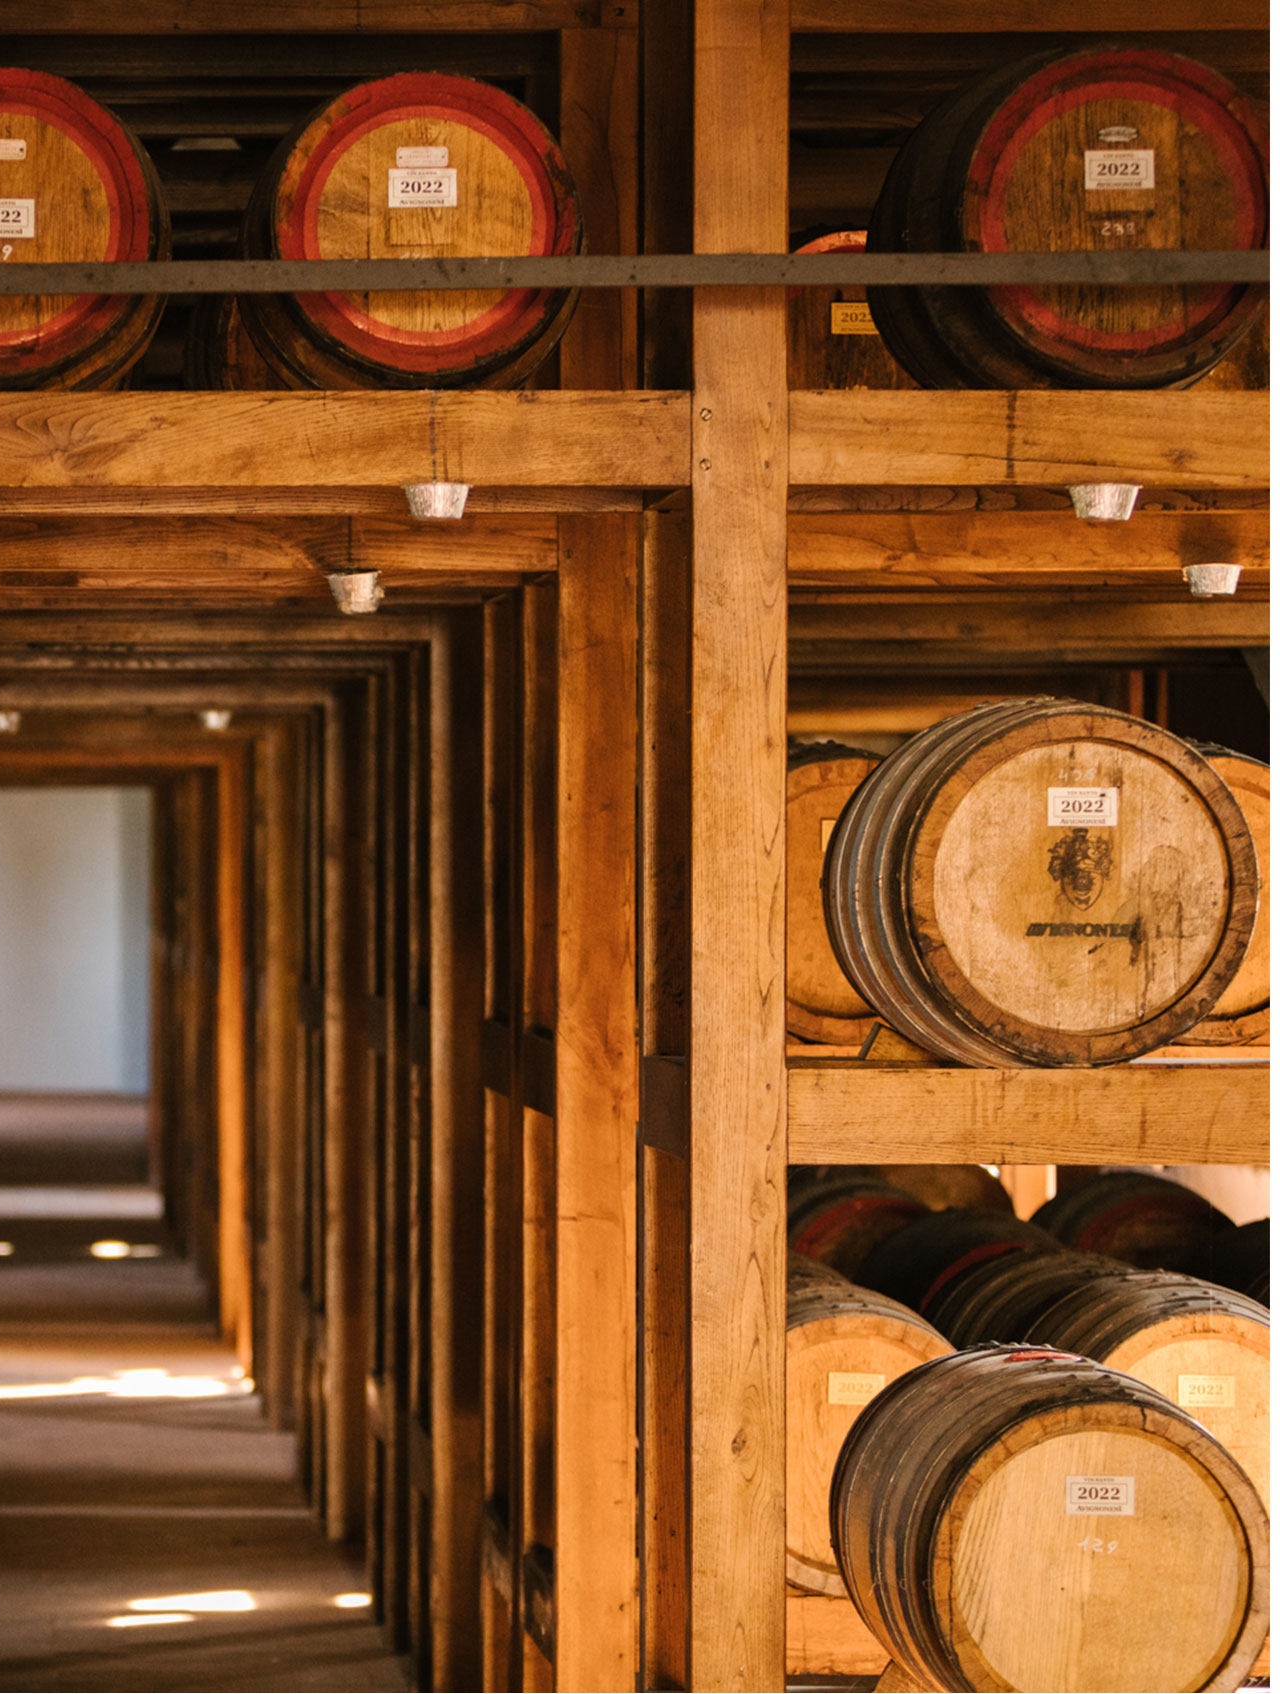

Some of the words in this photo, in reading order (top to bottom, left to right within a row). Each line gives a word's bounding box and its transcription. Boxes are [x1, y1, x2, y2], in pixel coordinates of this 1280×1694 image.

[1097, 163, 1140, 176] 2022
[400, 181, 443, 194] 2022
[1061, 800, 1104, 813] 2022
[1188, 1384, 1224, 1395] 2022
[1078, 1487, 1120, 1500] 2022
[1077, 1536, 1118, 1554] 129
